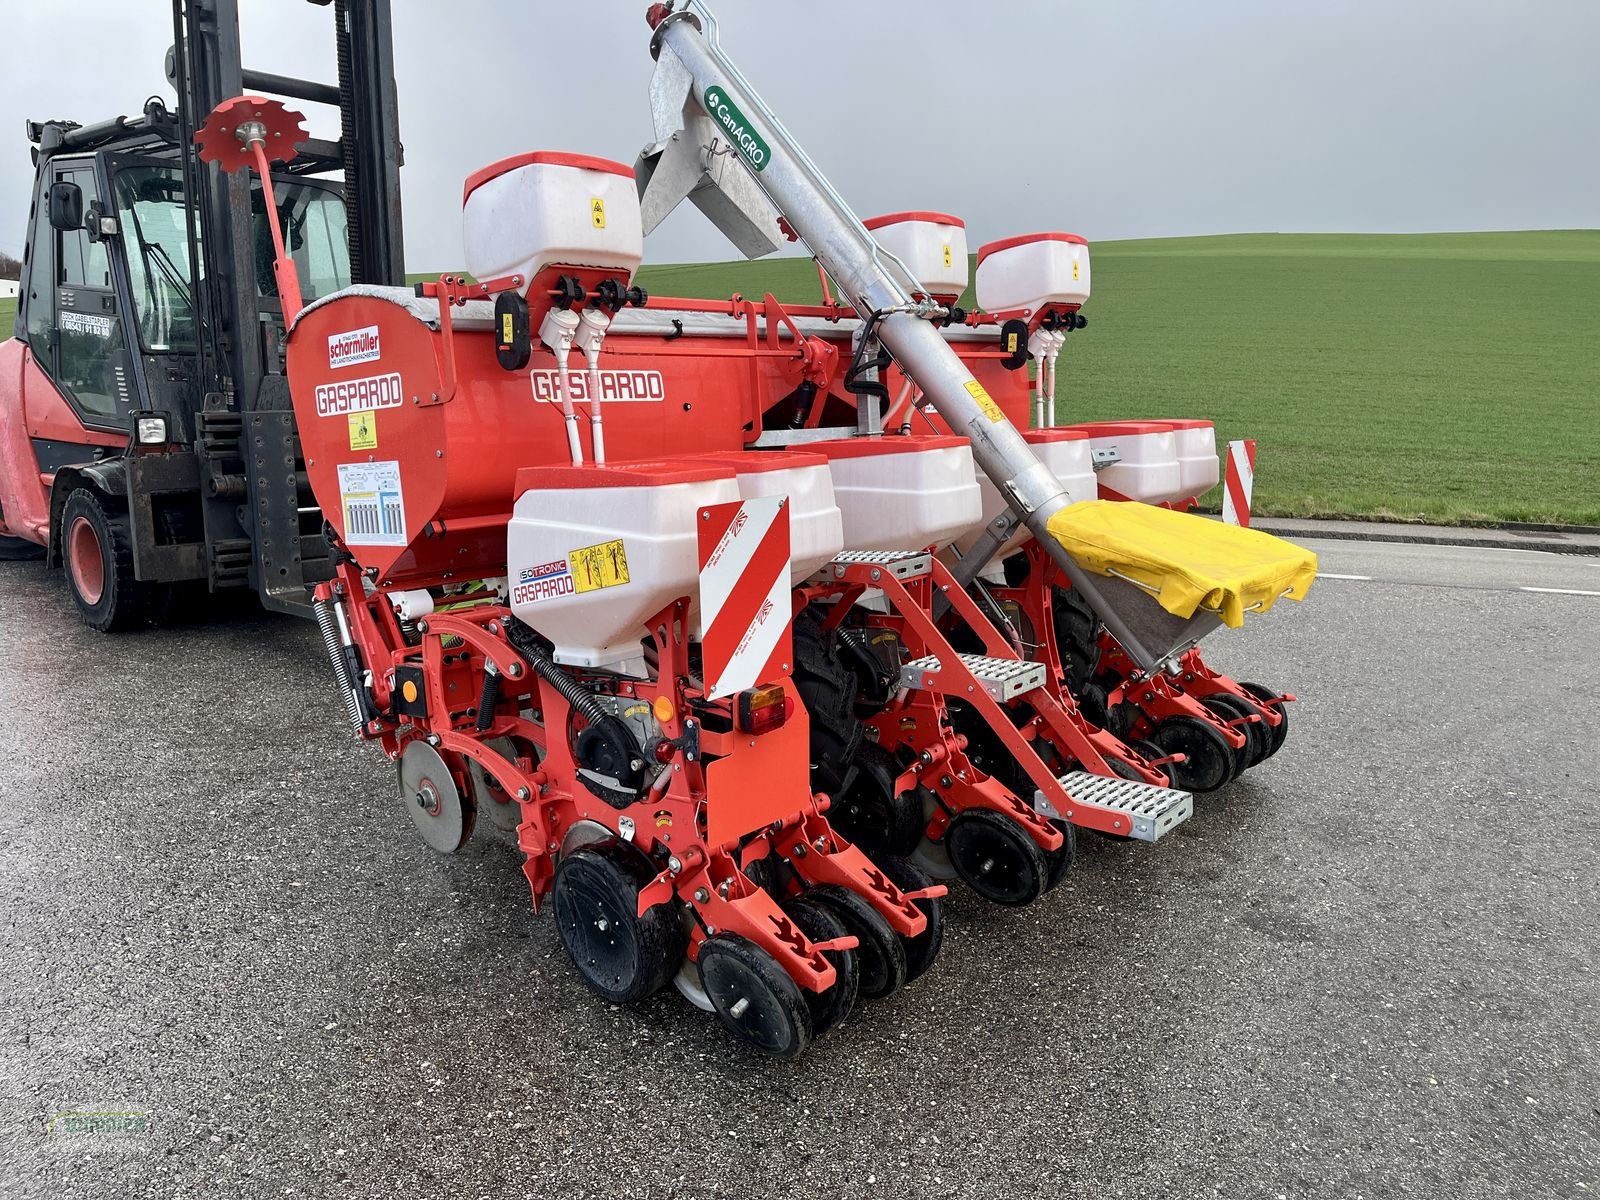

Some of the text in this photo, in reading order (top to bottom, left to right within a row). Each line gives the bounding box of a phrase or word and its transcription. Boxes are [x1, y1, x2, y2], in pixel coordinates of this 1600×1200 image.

[718, 105, 763, 163] CanAGRO
[66, 321, 81, 331] 08543
[85, 324, 92, 334] 91
[93, 326, 100, 335] 82
[102, 328, 109, 337] 80
[331, 332, 378, 359] scharmüller
[317, 375, 401, 414] GASPARDO
[514, 575, 574, 604] GASPARDO
